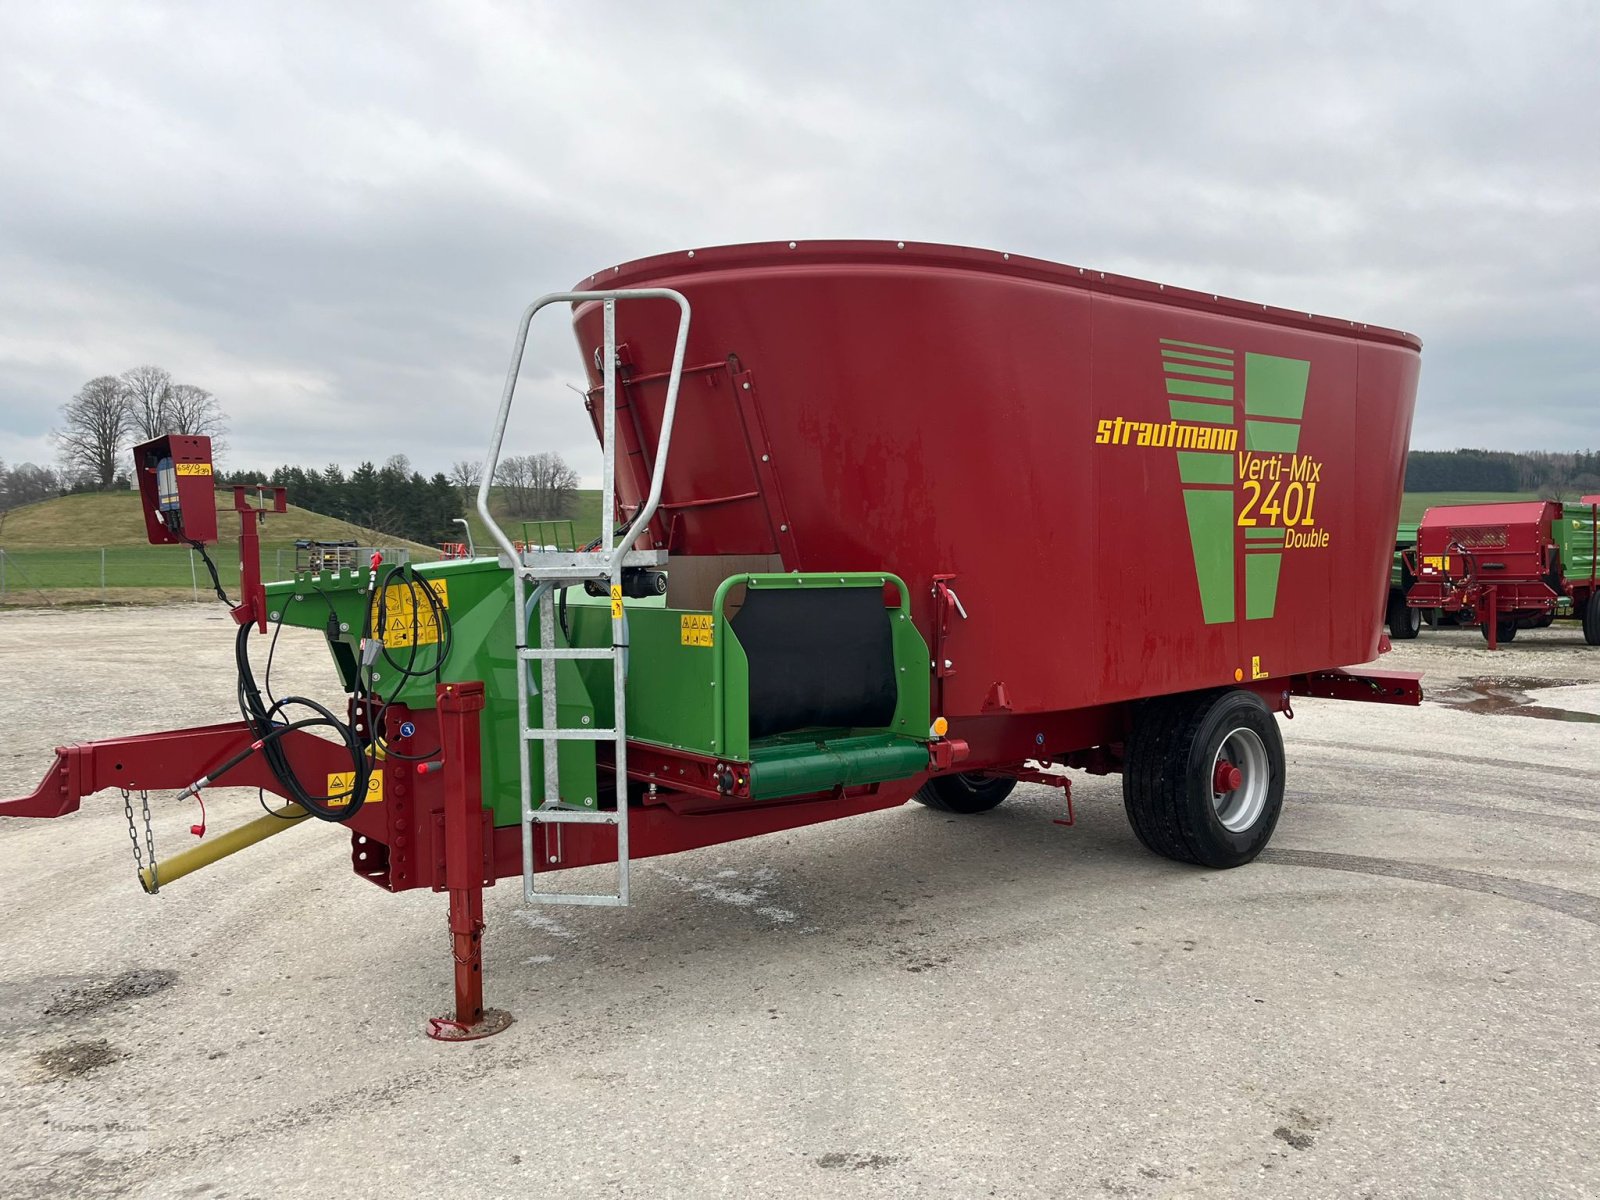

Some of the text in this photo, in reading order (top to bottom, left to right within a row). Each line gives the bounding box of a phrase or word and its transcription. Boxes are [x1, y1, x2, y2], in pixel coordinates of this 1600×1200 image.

[1095, 417, 1238, 451] strautmann
[1238, 450, 1323, 482] Verti-Mix
[1237, 480, 1318, 526] 2401
[1284, 527, 1330, 549] Double
